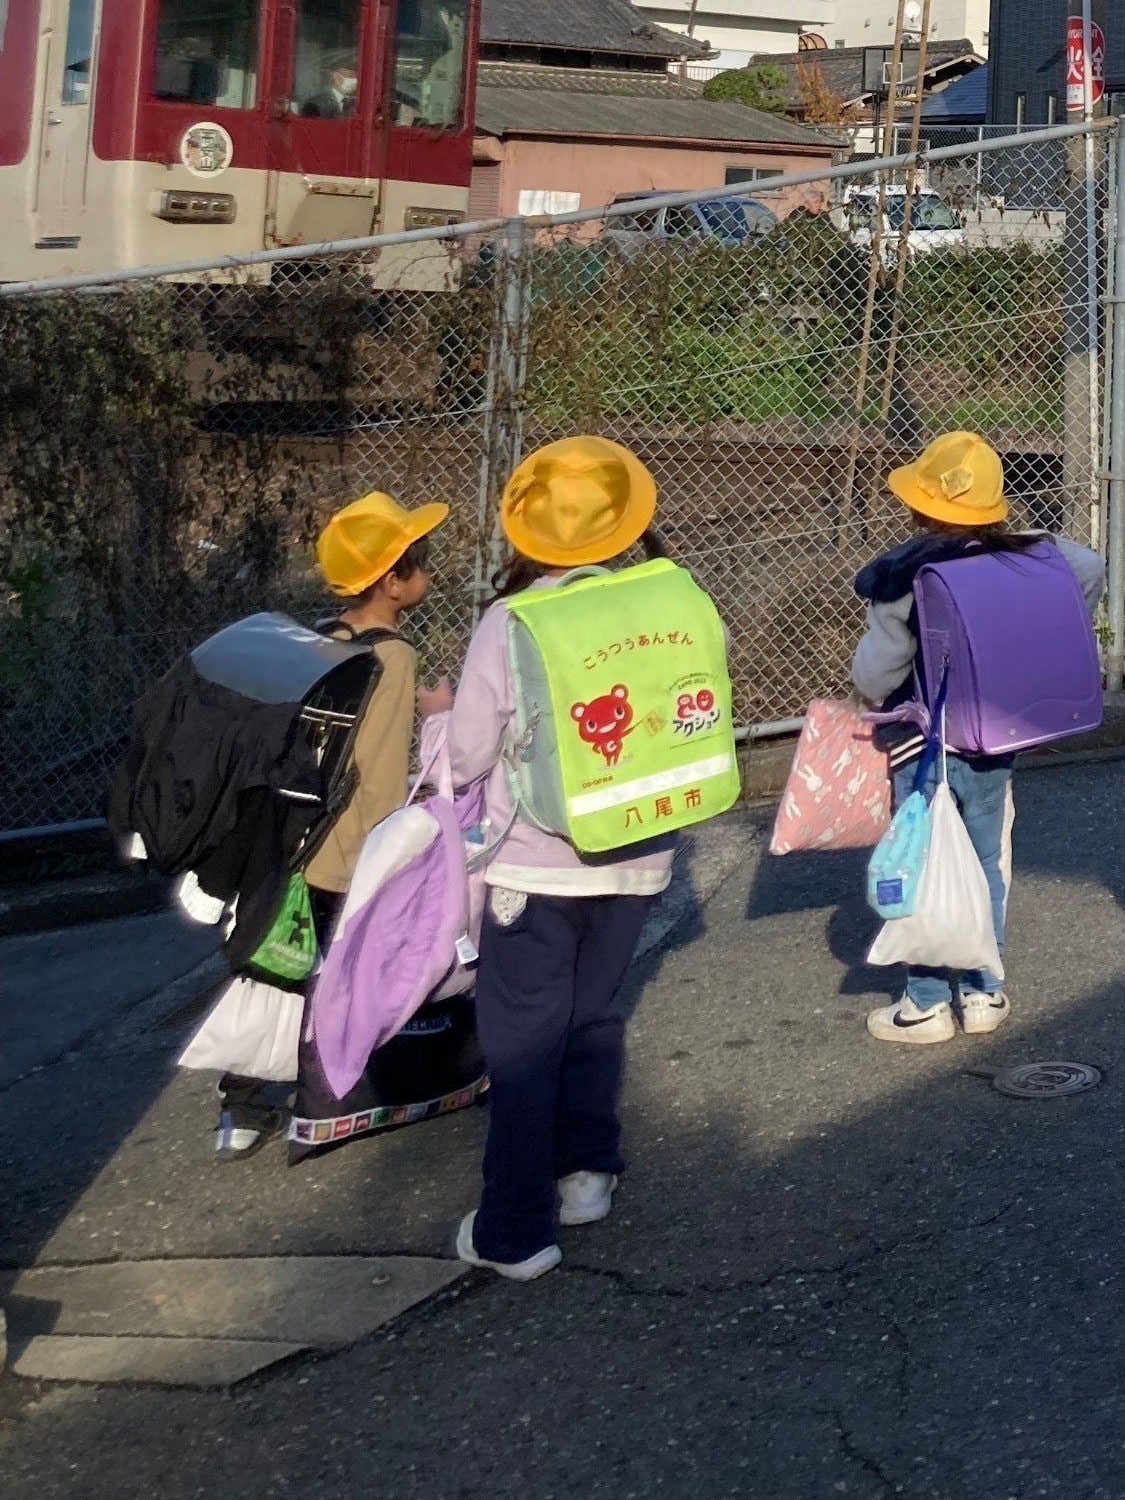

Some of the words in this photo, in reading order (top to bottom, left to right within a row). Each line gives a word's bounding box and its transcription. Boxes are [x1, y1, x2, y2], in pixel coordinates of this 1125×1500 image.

[583, 631, 693, 670] こうつうあんぜん
[672, 708, 721, 737] アクション
[625, 788, 702, 828] 八尾市
